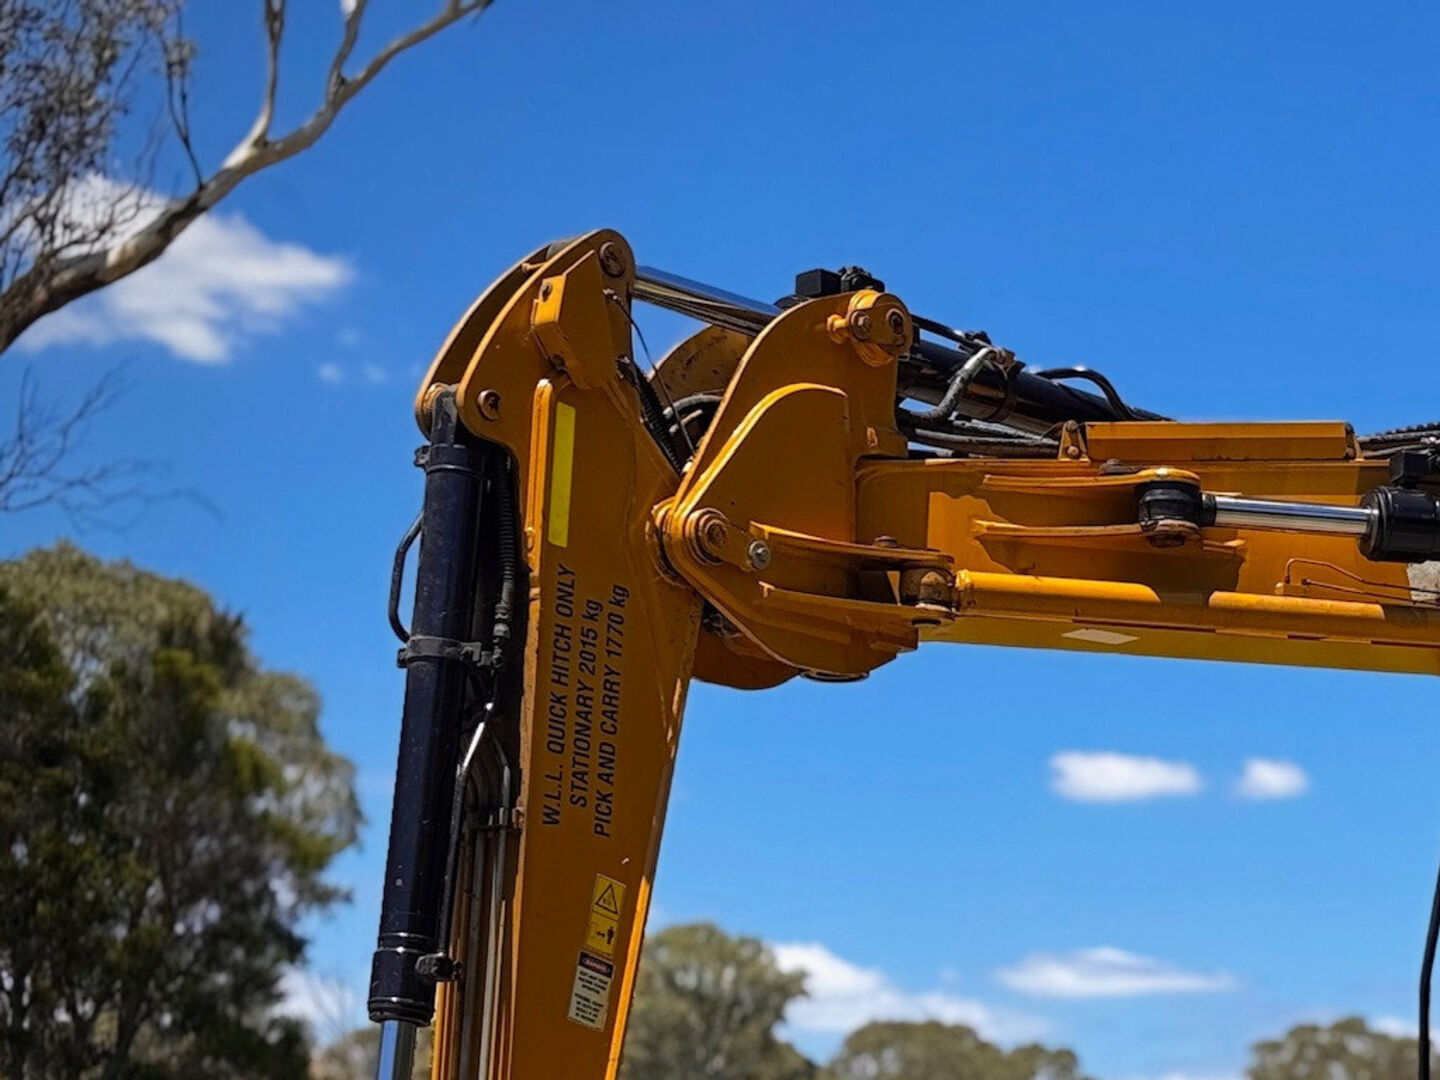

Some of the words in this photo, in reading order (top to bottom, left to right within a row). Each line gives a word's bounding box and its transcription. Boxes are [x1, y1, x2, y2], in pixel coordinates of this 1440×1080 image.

[555, 563, 576, 619] ONLY
[581, 599, 604, 622] kg
[608, 584, 630, 608] kg
[550, 622, 572, 687] HITCH
[578, 626, 598, 676] 2015
[605, 611, 624, 658] 1770
[546, 691, 568, 755] QUICK
[600, 663, 621, 736] CARRY
[569, 678, 595, 809] STATIONARY
[597, 741, 616, 786] AND
[541, 763, 564, 826] W.L.L.
[593, 789, 614, 838] PICK
